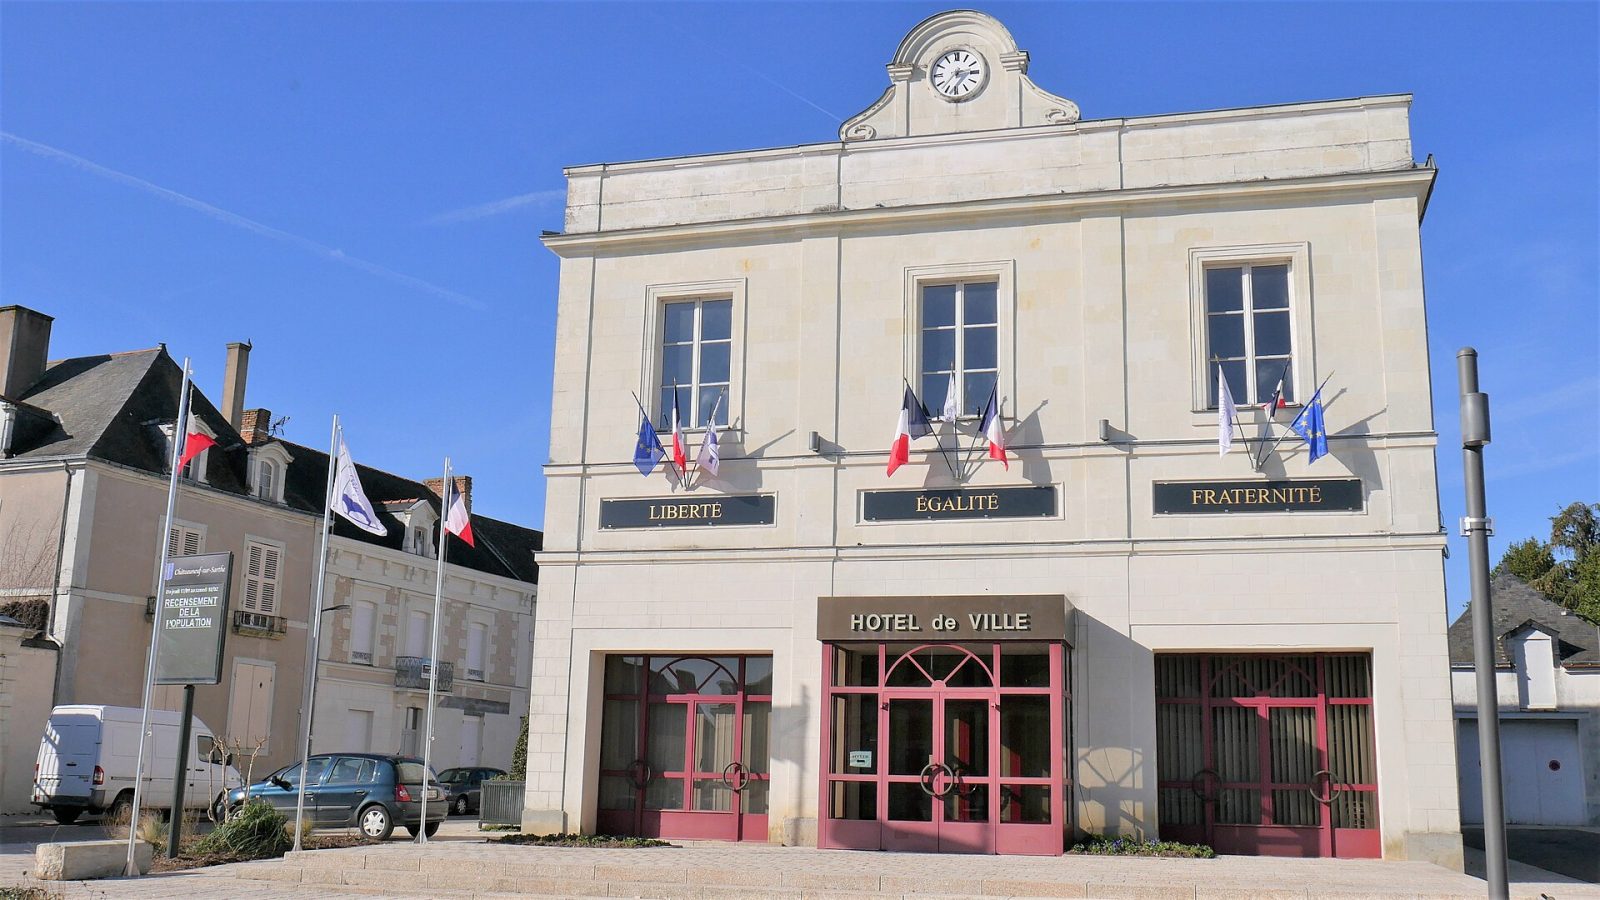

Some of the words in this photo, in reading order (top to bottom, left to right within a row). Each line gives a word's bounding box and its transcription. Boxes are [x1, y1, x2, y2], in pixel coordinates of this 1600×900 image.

[916, 493, 999, 512] ÉGALITÉ
[1191, 485, 1322, 505] FRATERNITÉ
[649, 501, 722, 520] LIBERTÉ
[165, 597, 218, 608] RECENSEMENT
[179, 608, 190, 617] DE
[190, 608, 200, 617] LA
[850, 613, 921, 631] HOTEL
[931, 613, 958, 631] de
[968, 612, 1029, 631] VILLE
[165, 617, 212, 629] POPULATION
